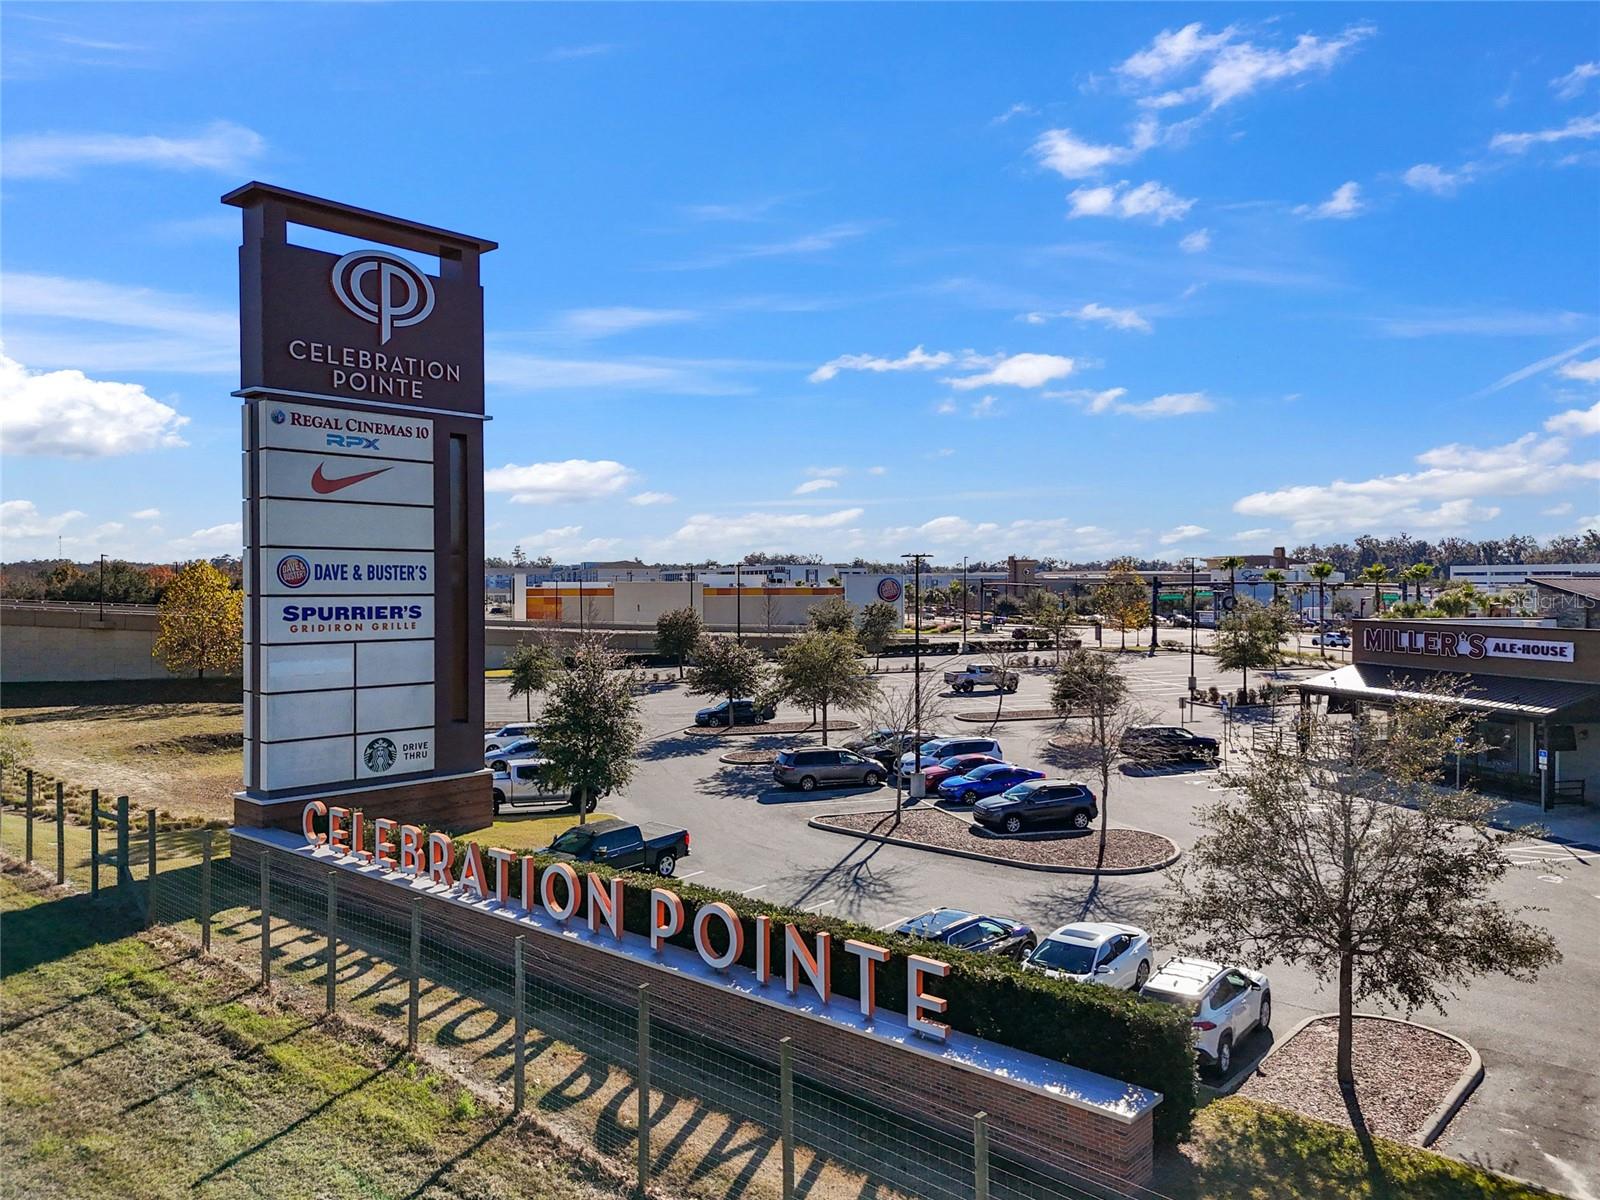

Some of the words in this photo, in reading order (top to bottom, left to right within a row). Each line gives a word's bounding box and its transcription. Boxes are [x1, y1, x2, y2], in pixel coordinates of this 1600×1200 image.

[289, 340, 461, 382] CELEBRATION
[333, 369, 424, 399] POINTE
[290, 412, 343, 430] REGAL
[345, 418, 413, 438] CINEMAS
[415, 426, 430, 439] 10
[326, 433, 380, 451] RPX
[314, 563, 348, 581] DAVE
[352, 564, 363, 581] &
[367, 564, 427, 581] BUSTER'S
[282, 605, 422, 622] SPURRIER'S
[289, 623, 363, 633] GRIDIRON
[371, 621, 417, 631] GRILLE
[1364, 627, 1487, 660] MILLER'S
[402, 741, 429, 752] DRIVE
[404, 751, 428, 760] THRU
[302, 800, 624, 939] CELEBRATION
[650, 887, 951, 1039] POINTE
